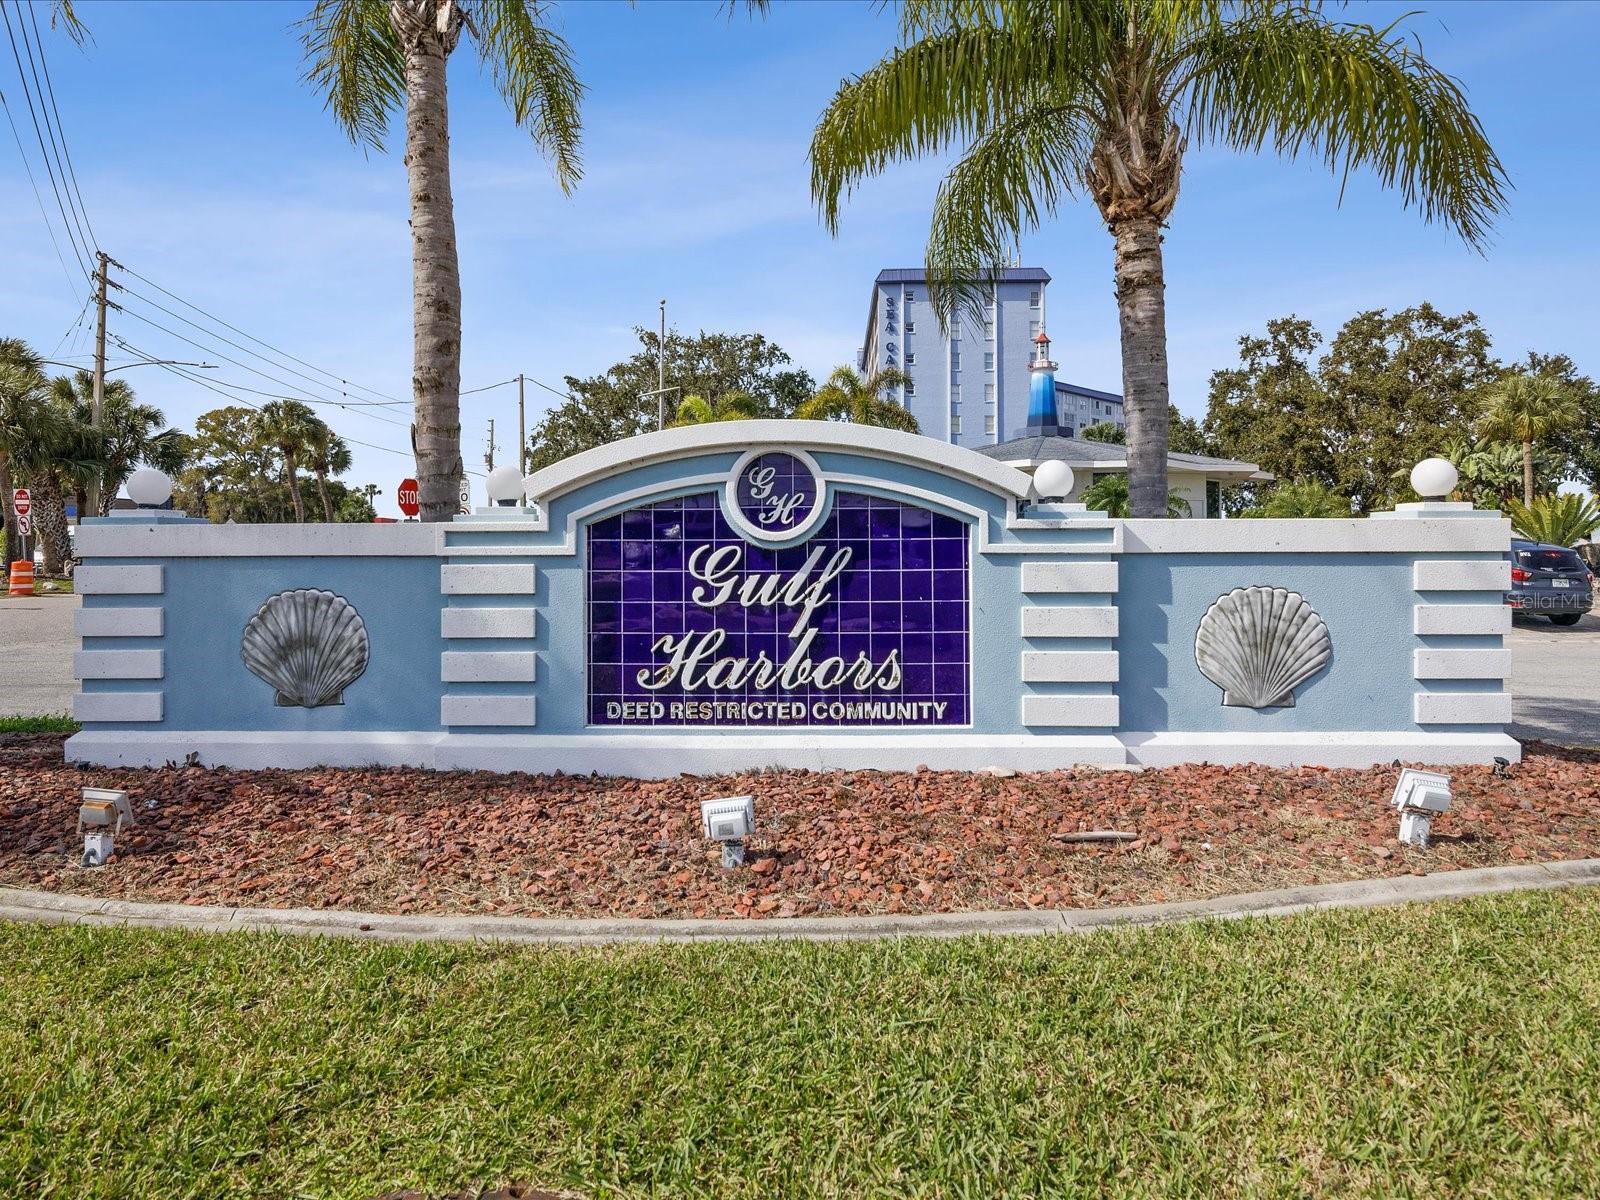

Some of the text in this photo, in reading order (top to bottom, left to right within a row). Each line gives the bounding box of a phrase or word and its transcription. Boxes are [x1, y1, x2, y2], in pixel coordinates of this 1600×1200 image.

[885, 297, 895, 332] SEA
[748, 467, 776, 499] G
[758, 492, 805, 524] H
[688, 544, 853, 638] Gulf
[636, 627, 901, 691] Harbors
[606, 701, 948, 720] DEED RESTRICTED COMMUNITY
